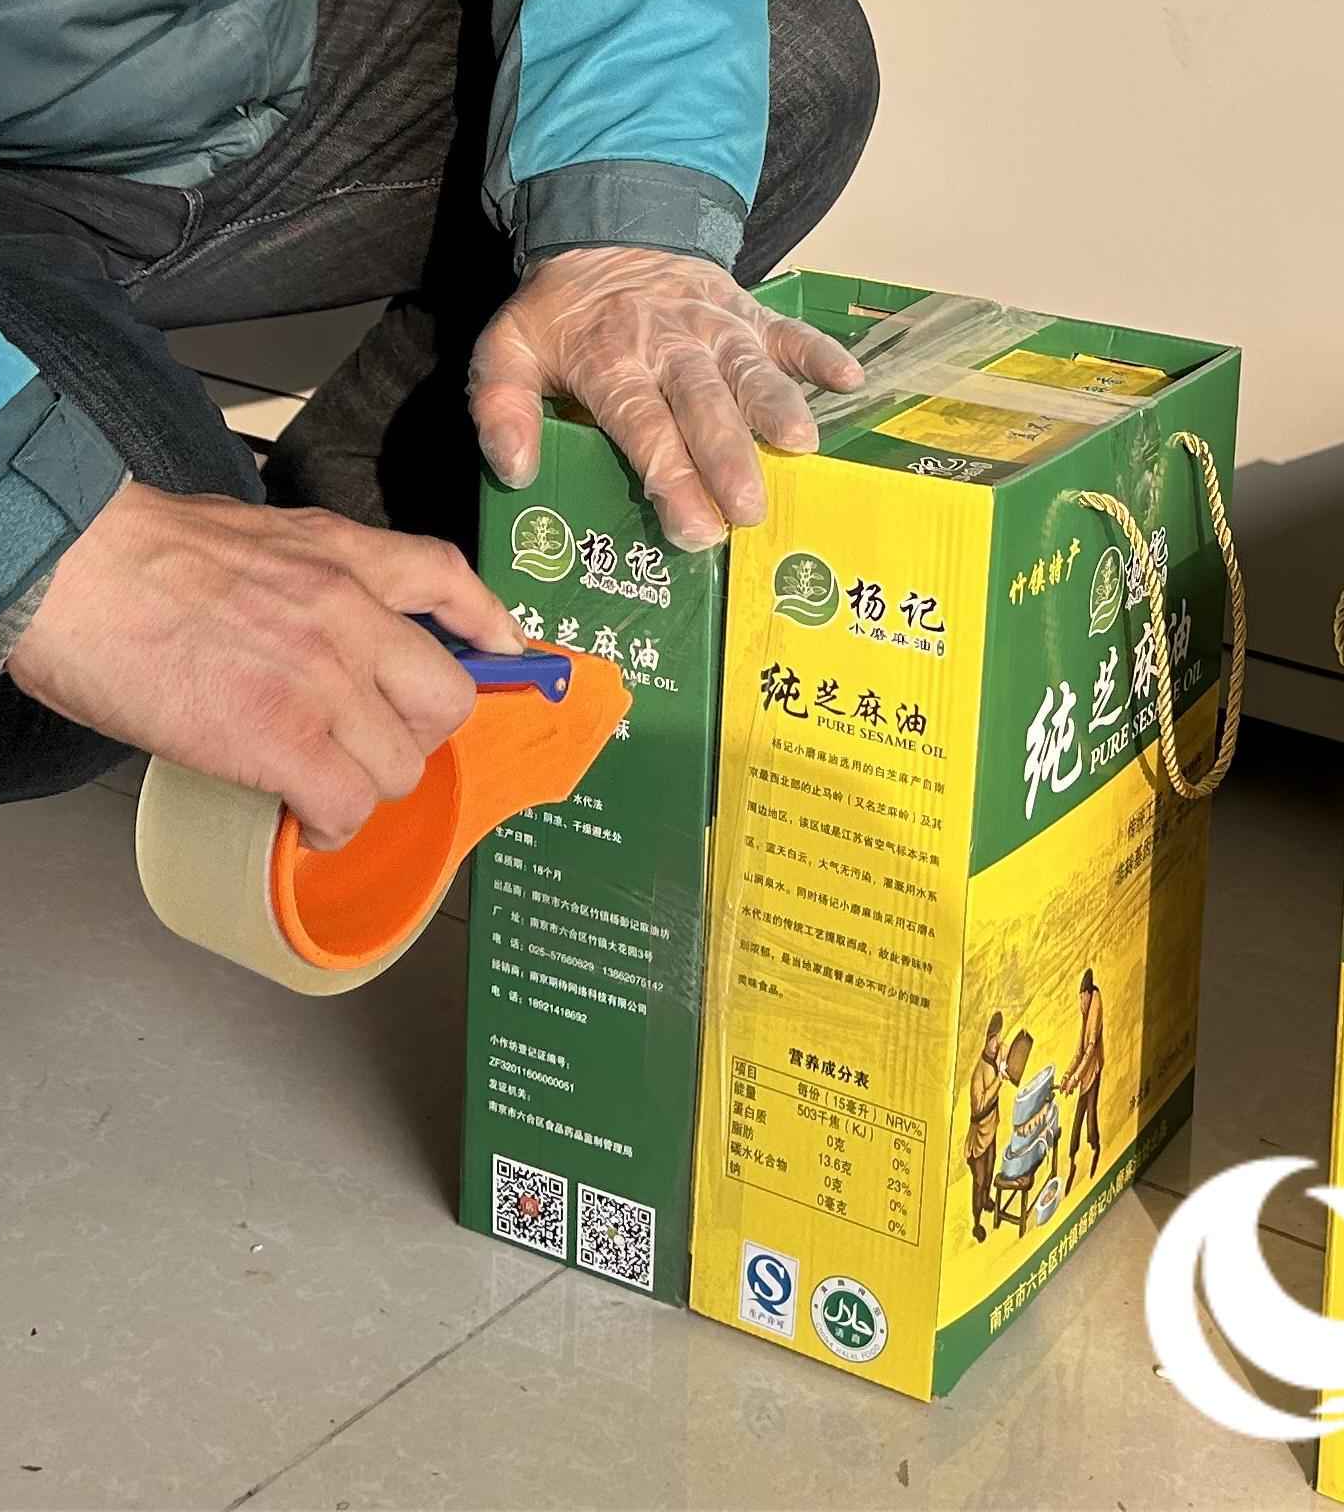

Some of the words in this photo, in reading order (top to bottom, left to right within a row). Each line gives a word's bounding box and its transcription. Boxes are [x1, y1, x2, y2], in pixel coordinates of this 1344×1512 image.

[578, 528, 671, 585] 杨记
[1009, 538, 1081, 605] 竹镇特产
[846, 578, 945, 633] 杨记
[848, 624, 931, 651] 小磨麻油
[655, 676, 678, 691] OIL
[760, 662, 928, 736] 纯芝麻油
[817, 716, 855, 736] PURE
[859, 727, 917, 752] SESAME
[921, 743, 947, 760] OIL
[1088, 724, 1129, 775] PURE
[1183, 659, 1202, 693] OIL
[788, 1047, 871, 1090] 营养成分表
[733, 1101, 767, 1125] 蛋白质
[827, 1134, 845, 1153] 0克
[892, 1158, 910, 1175] 0%
[734, 1081, 756, 1101] 能量
[894, 1137, 912, 1154] 6%
[886, 1114, 922, 1137] NRV%
[730, 1141, 788, 1173] 碳水化合物
[824, 1176, 843, 1194] 0克
[889, 1199, 908, 1216] 0%
[731, 1121, 753, 1141] 脂肪
[818, 1153, 852, 1177] 13.6克
[887, 1178, 912, 1197] 23%
[817, 1194, 848, 1216] 0毫克
[888, 1219, 906, 1236] 0%
